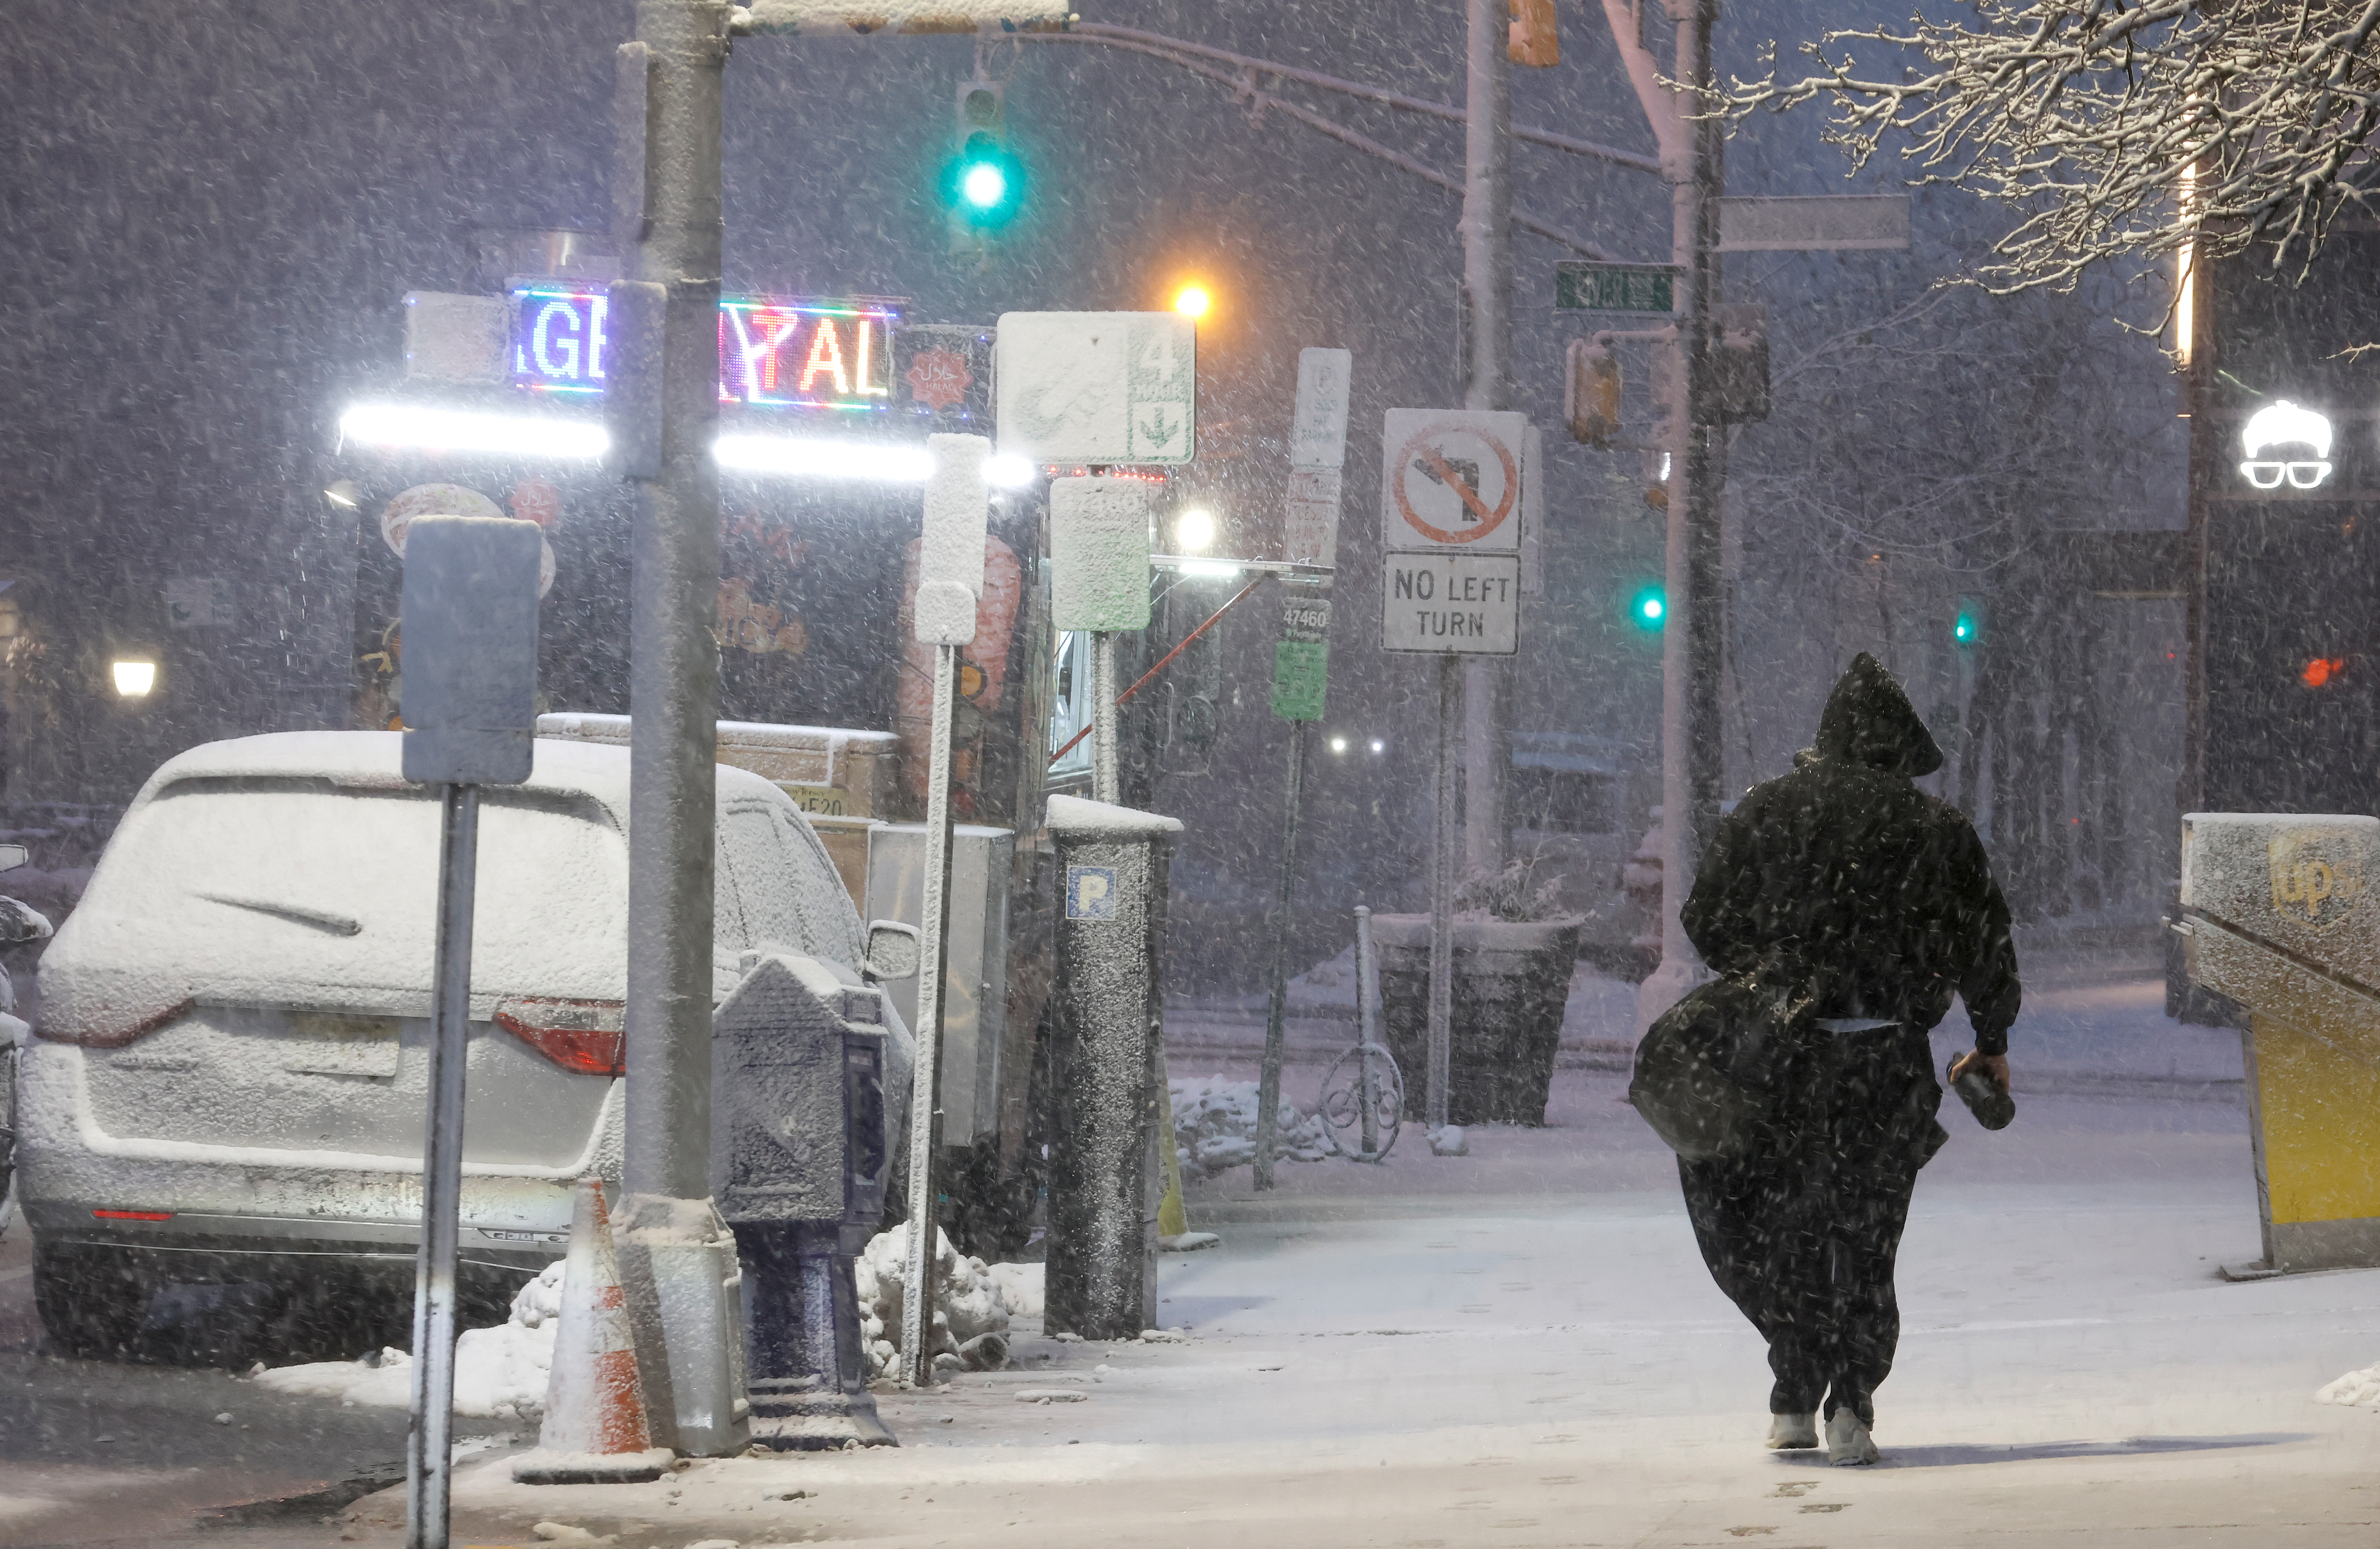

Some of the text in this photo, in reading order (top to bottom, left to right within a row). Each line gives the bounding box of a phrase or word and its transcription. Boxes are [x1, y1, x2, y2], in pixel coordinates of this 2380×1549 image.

[1140, 336, 1179, 381] 4
[926, 382, 952, 390] HALAL
[1396, 569, 1510, 602] NO LEFT
[1283, 609, 1327, 627] 47460
[1417, 610, 1484, 637] TURN
[801, 788, 825, 797] Jersey
[1079, 875, 1108, 911] P
